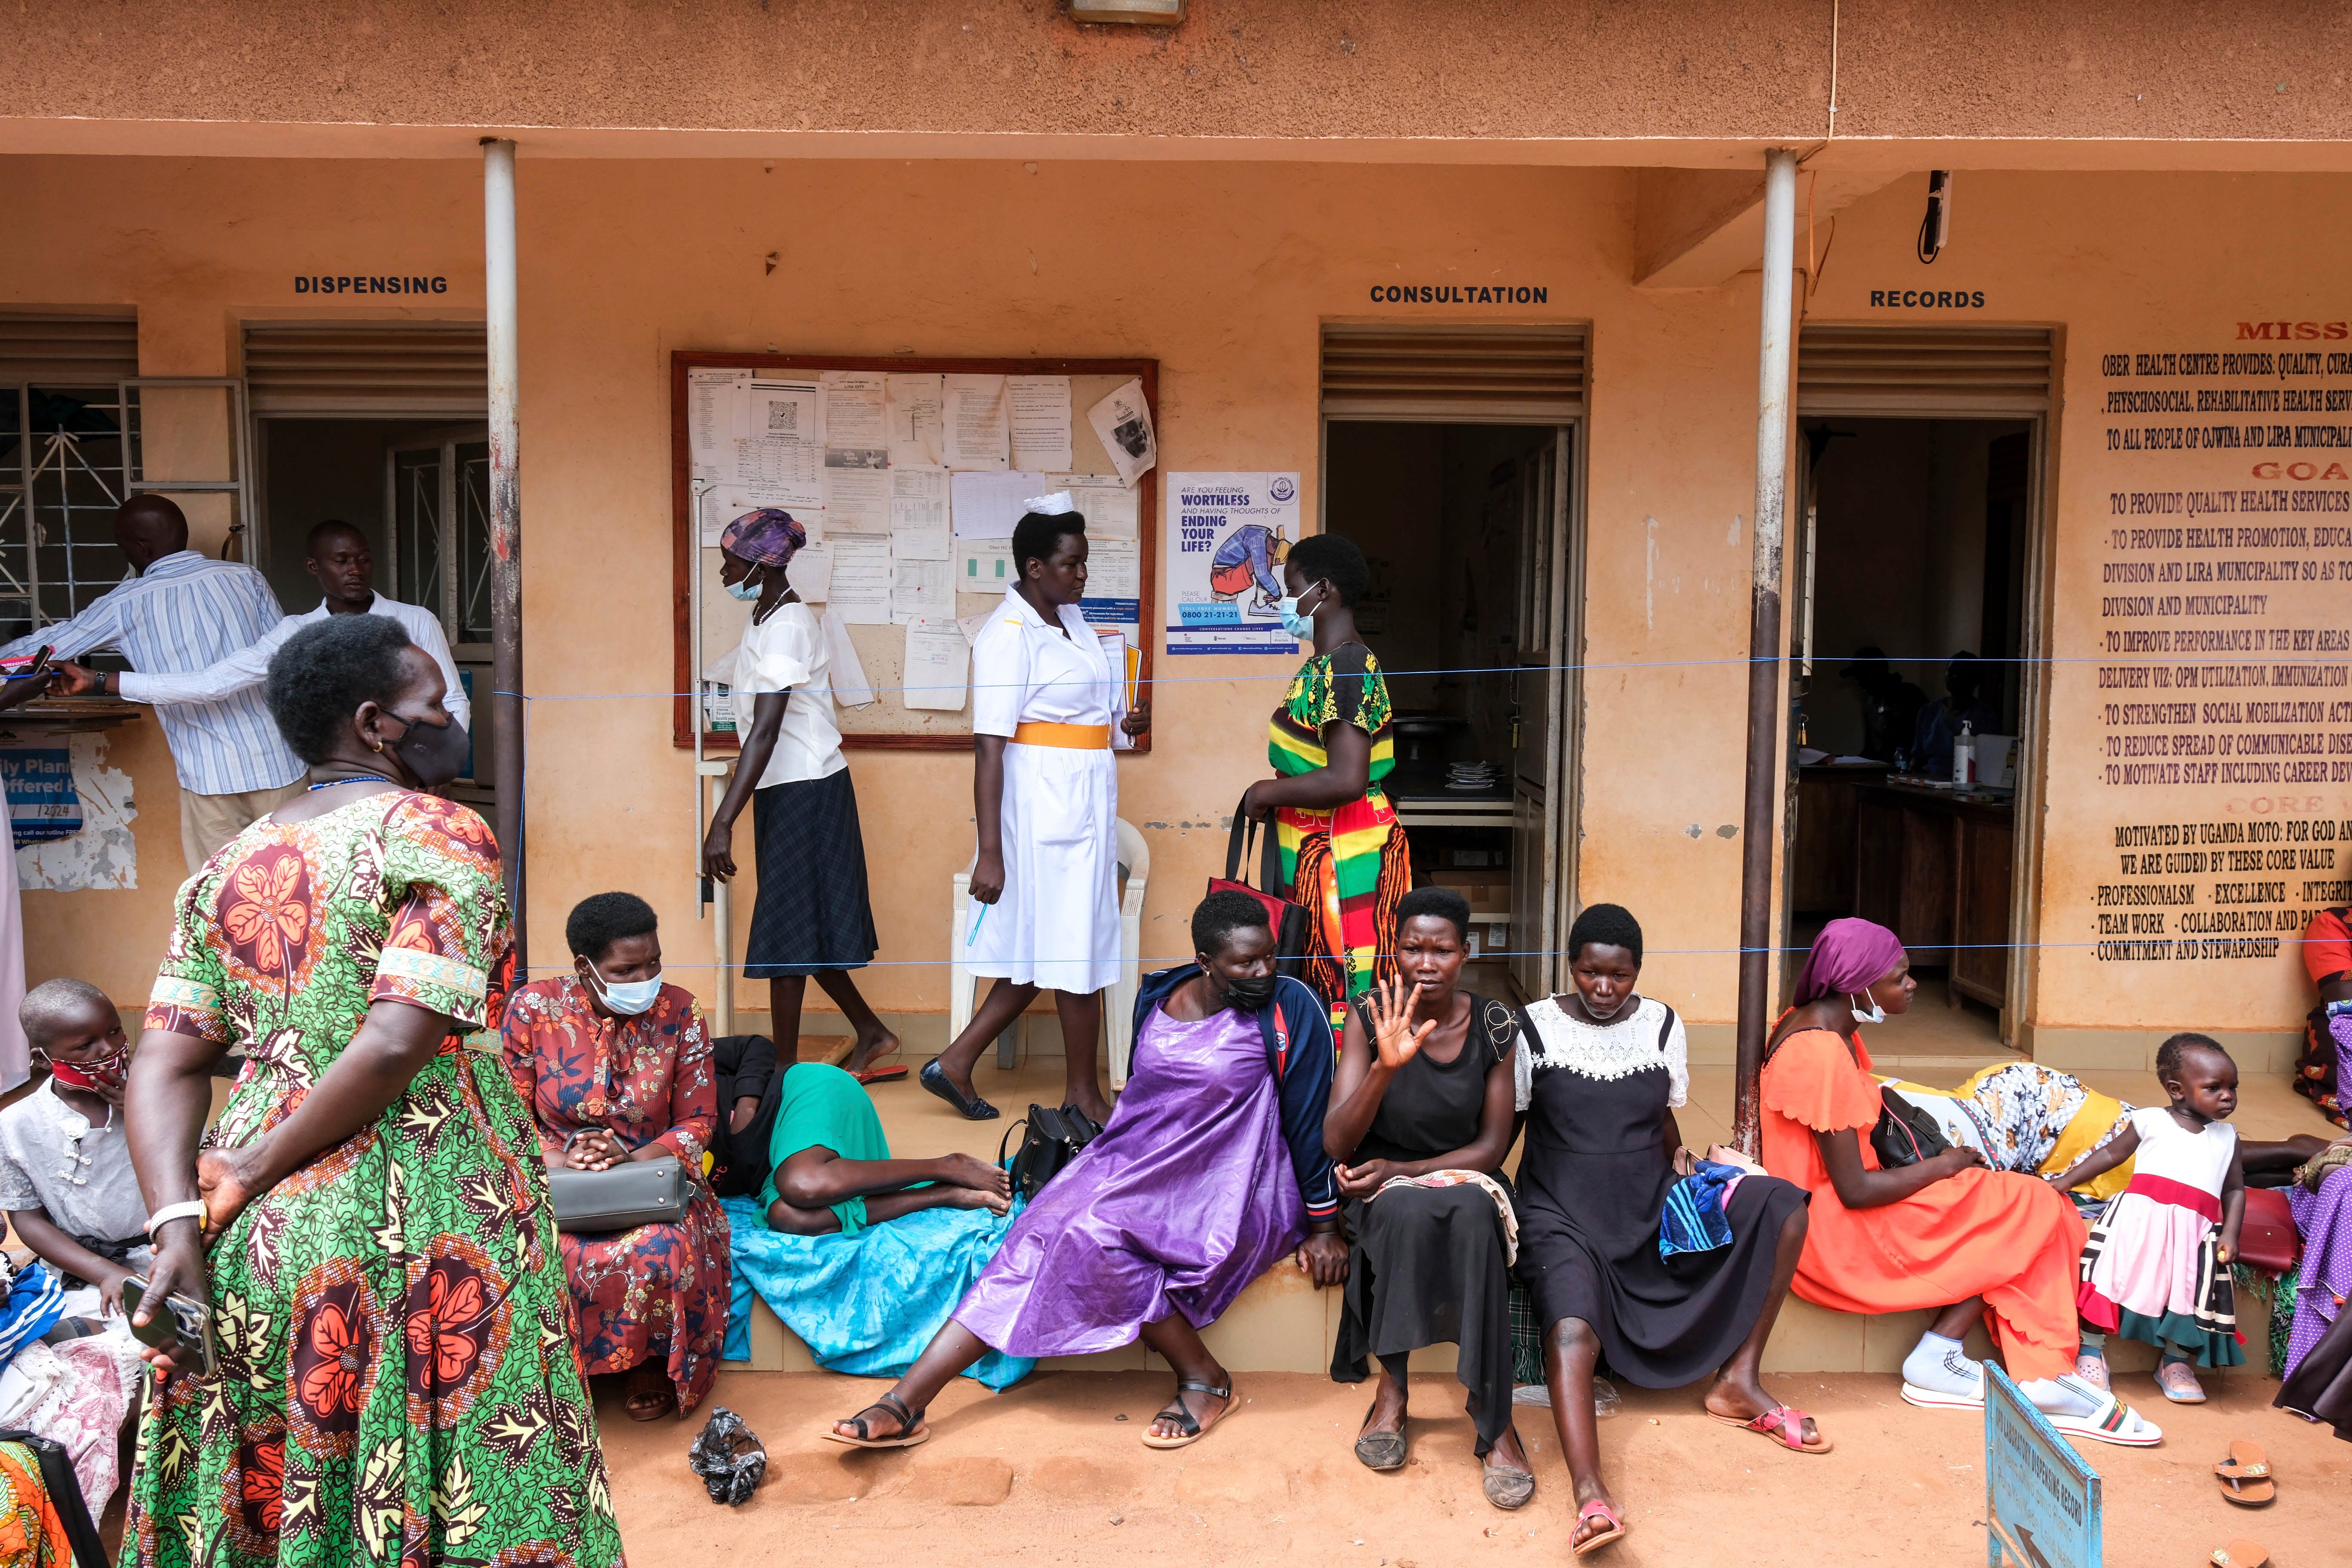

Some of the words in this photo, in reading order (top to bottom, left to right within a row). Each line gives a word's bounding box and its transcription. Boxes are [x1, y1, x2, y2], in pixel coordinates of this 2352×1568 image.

[295, 276, 447, 294] DISPENSING
[1370, 286, 1547, 303] CONSULTATION
[1871, 291, 1984, 308] RECORDS
[2103, 354, 2130, 377] OBER
[2136, 354, 2176, 376] HEALTH
[2179, 353, 2219, 375] CENTRE
[2223, 353, 2275, 375] PROVIDES:
[2278, 352, 2323, 380] QUALITY,
[2197, 390, 2279, 412] REHABILITATIVE
[2283, 390, 2322, 412] HEALTH
[2107, 429, 2119, 450] TO
[2123, 428, 2141, 450] ALL
[2144, 428, 2183, 449] PEOPLE
[2186, 427, 2200, 449] OF
[2202, 426, 2240, 449] OJWINA
[2243, 426, 2264, 447] AND
[2267, 426, 2291, 447] LIRA
[1182, 495, 1250, 506] WORTHLESS
[2110, 493, 2126, 514] TO
[2130, 492, 2183, 514] PROVIDE
[2187, 491, 2238, 518] QUALITY
[2241, 490, 2288, 512] HEALTH
[2291, 490, 2350, 512] SERVICES
[1181, 528, 1214, 539] YOUR
[1182, 516, 1227, 527] ENDING
[1182, 541, 1212, 552] LIFE?
[2112, 529, 2127, 549] TO
[2131, 528, 2183, 549] PROVIDE
[2186, 528, 2233, 548] HEALTH
[2237, 527, 2309, 551] PROMOTION,
[2103, 562, 2155, 583] DIVISION
[2158, 562, 2182, 582] AND
[2186, 562, 2213, 582] LIRA
[2217, 561, 2299, 581] MUNICIPALITY
[2302, 561, 2317, 581] SO
[2321, 561, 2334, 580] AS
[2338, 561, 2352, 581] TO
[2102, 597, 2154, 617] DIVISION
[2157, 596, 2182, 616] AND
[2185, 594, 2268, 616] MUNICIPALITY
[2106, 630, 2120, 652] TO
[2123, 631, 2170, 652] IMPROVE
[2174, 630, 2252, 652] PERFORMANCE
[2254, 629, 2266, 651] IN
[2269, 629, 2290, 651] THE
[2293, 629, 2315, 651] KEY
[2316, 630, 2350, 651] AREAS
[2099, 667, 2150, 689] DELIVERY
[2153, 667, 2173, 688] VIZ:
[2175, 666, 2199, 687] OPM
[2271, 665, 2349, 687] IMMUNIZATION
[2105, 704, 2119, 725] TO
[2123, 702, 2196, 725] STRENGTHEN
[2202, 702, 2242, 725] SOCIAL
[2246, 701, 2324, 724] MOBILIZATION
[2106, 735, 2121, 757] TO
[2124, 735, 2169, 756] REDUCE
[2172, 734, 2215, 756] SPREAD
[2219, 734, 2233, 755] OF
[2236, 733, 2324, 756] COMMUNICABLE
[2106, 764, 2120, 785] TO
[2123, 763, 2180, 784] MOTIVATE
[2184, 763, 2219, 784] STAFF
[2221, 762, 2281, 784] INCLUDING
[2283, 761, 2328, 783] CAREER
[2225, 796, 2324, 815] CORE
[2115, 824, 2179, 847] MOTIVATED
[2182, 824, 2197, 845] BY
[2200, 822, 2244, 845] UGANDA
[2248, 821, 2283, 843] MOTO:
[2286, 821, 2309, 842] FOR
[2312, 821, 2335, 842] GOD
[2120, 854, 2138, 875] WE
[2140, 853, 2162, 874] ARE
[2165, 852, 2207, 873] GUIDED
[2211, 851, 2225, 873] BY
[2228, 850, 2264, 872] THESE
[2266, 849, 2296, 871] CORE
[2300, 848, 2335, 869] VALUE
[2098, 884, 2195, 906] PROFESSIONALSM
[2215, 882, 2286, 904] EXCELLENCE
[2098, 913, 2128, 934] TEAM
[2132, 913, 2165, 934] WORK
[2181, 910, 2272, 934] COLLABORATION
[2275, 910, 2297, 931] AND
[2098, 940, 2173, 962] COMMITMENT
[2176, 939, 2198, 961] AND
[2202, 937, 2279, 959] STEWARDSHIP
[2004, 1416, 2031, 1466] LABORATORY
[2032, 1448, 2060, 1502] DISPENSING
[2061, 1483, 2082, 1527] RECORD
